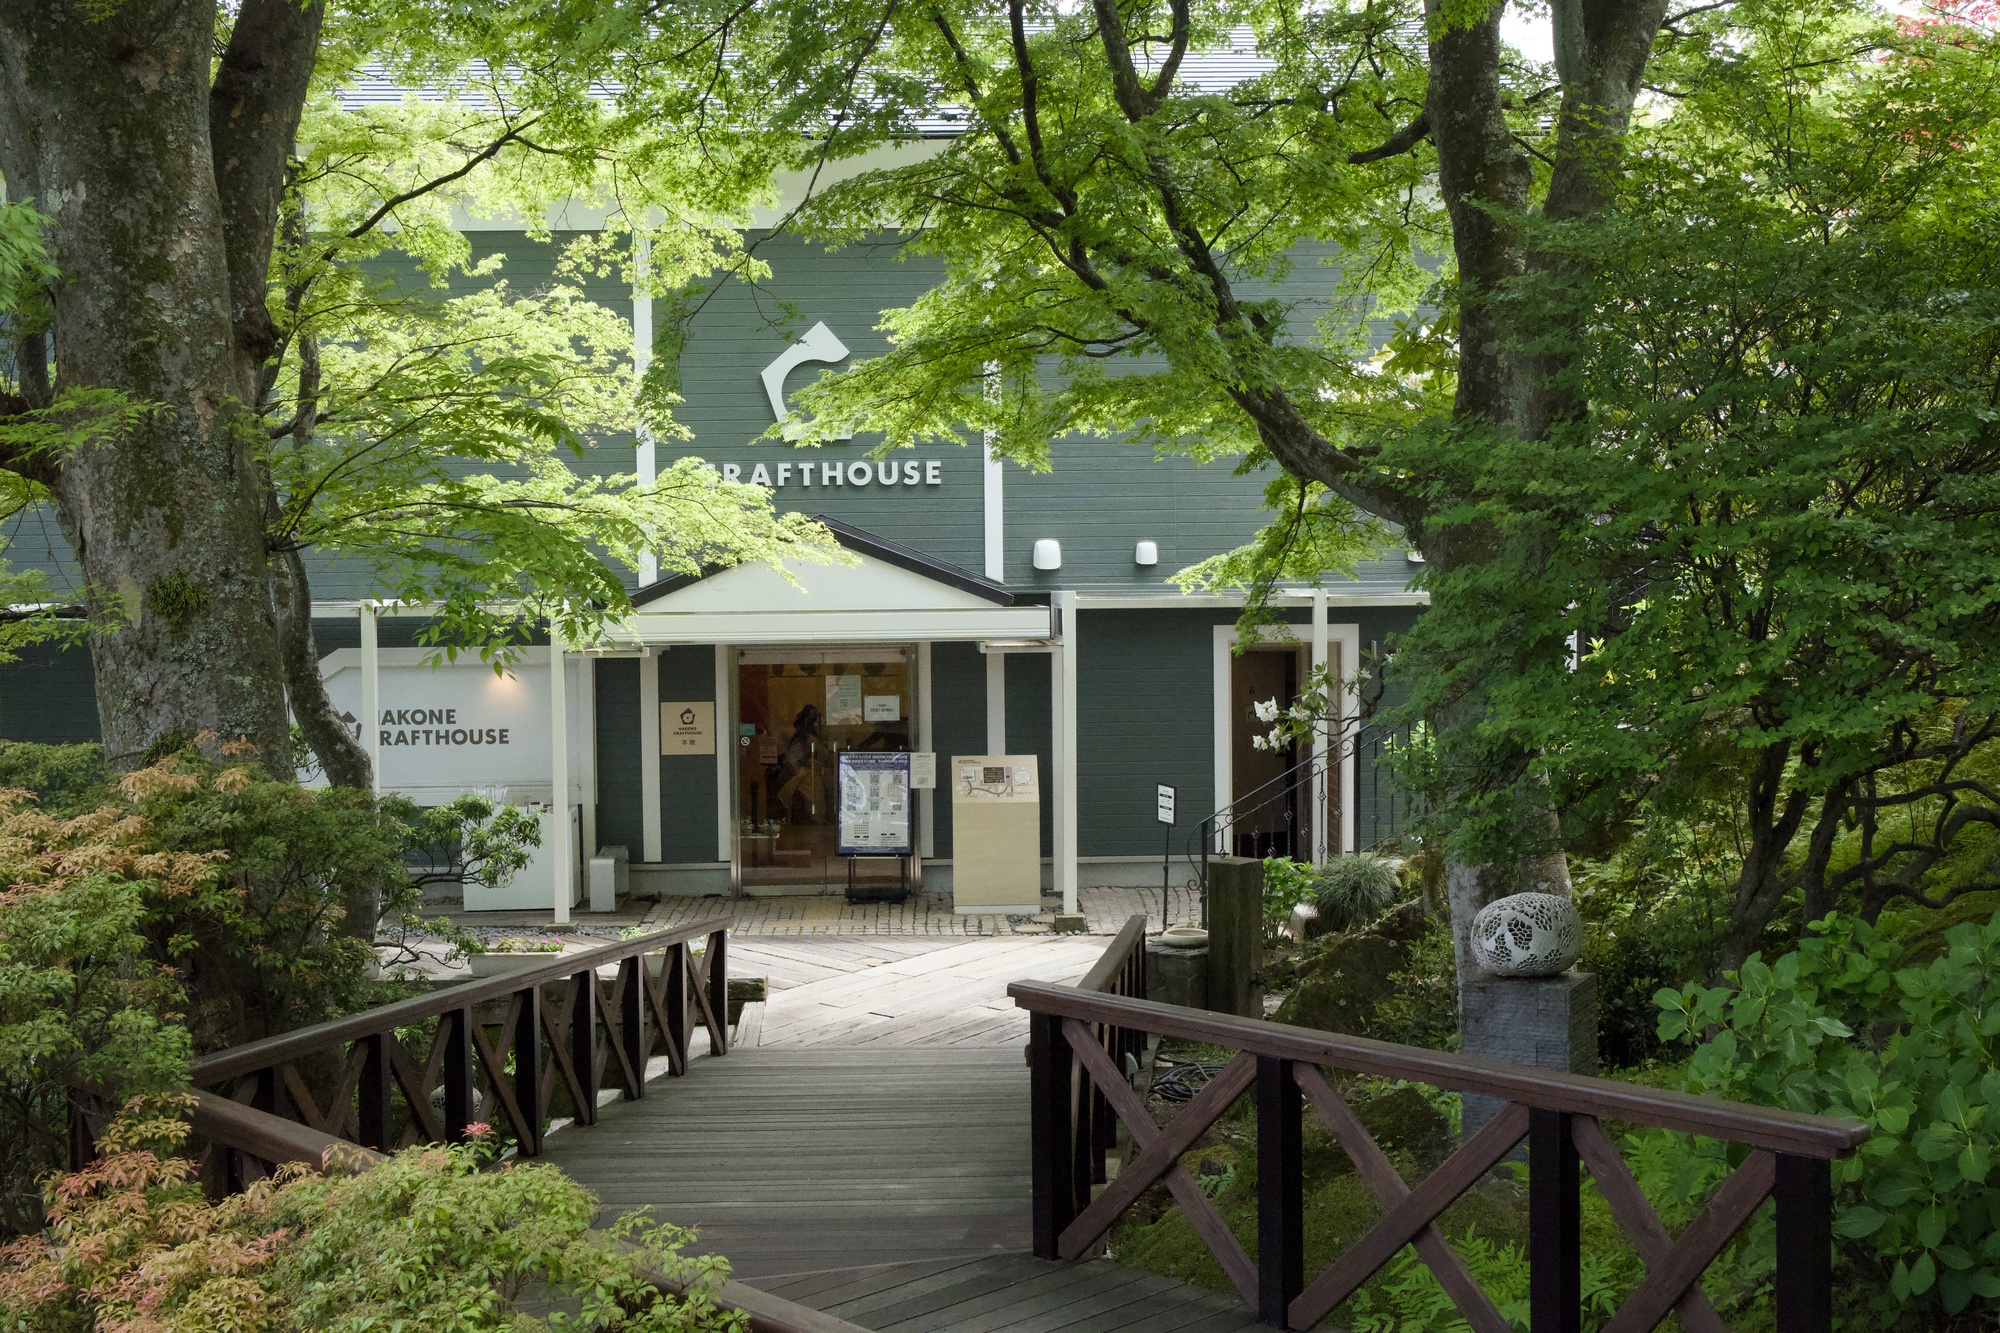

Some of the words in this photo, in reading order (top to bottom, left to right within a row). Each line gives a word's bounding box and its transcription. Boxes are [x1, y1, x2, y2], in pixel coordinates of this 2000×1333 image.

[704, 461, 942, 487] RAFTHOUSE
[378, 708, 457, 726] AKONE
[379, 728, 510, 746] RAFTHOUSE
